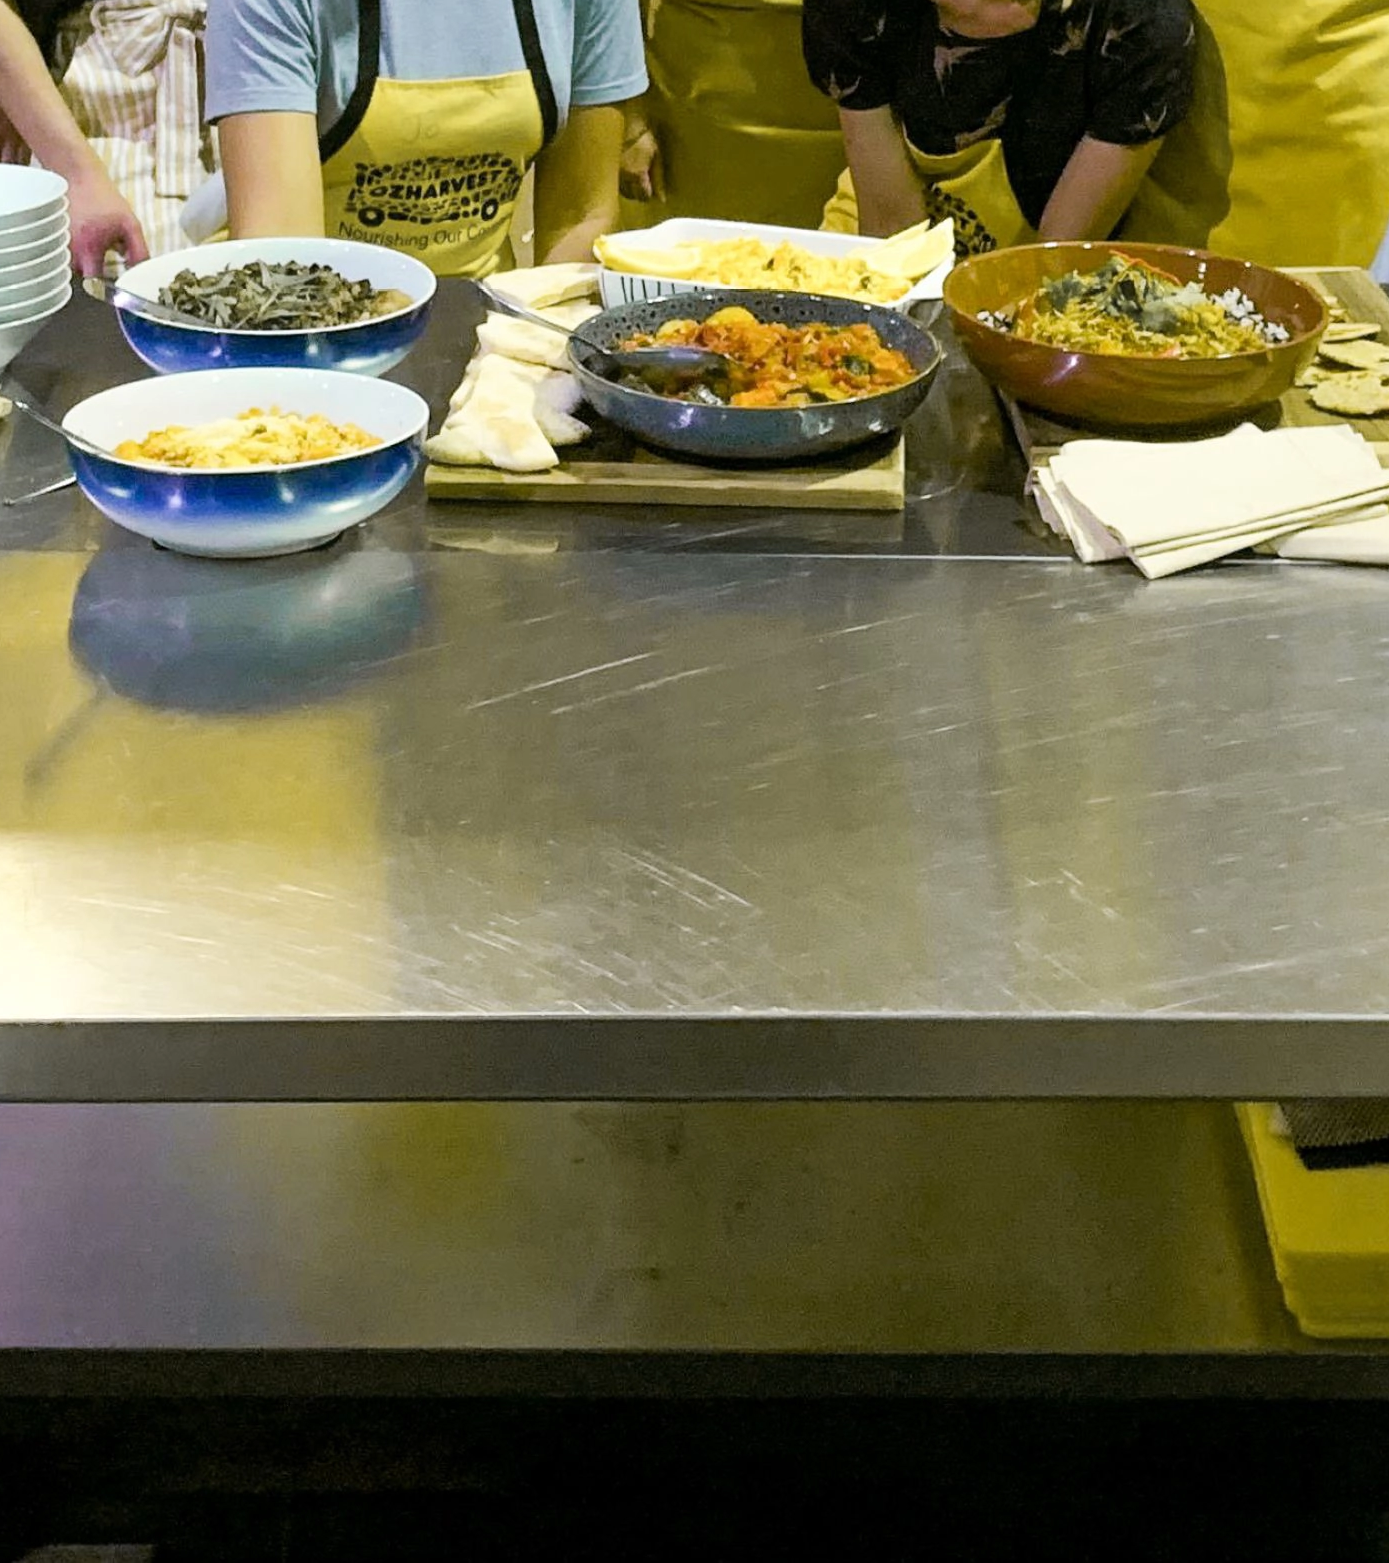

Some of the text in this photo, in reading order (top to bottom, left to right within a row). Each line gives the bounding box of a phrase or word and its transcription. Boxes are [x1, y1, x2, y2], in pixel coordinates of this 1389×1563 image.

[369, 169, 504, 200] OZHARVEST
[338, 221, 429, 251] Nourishing
[433, 229, 462, 244] Our
